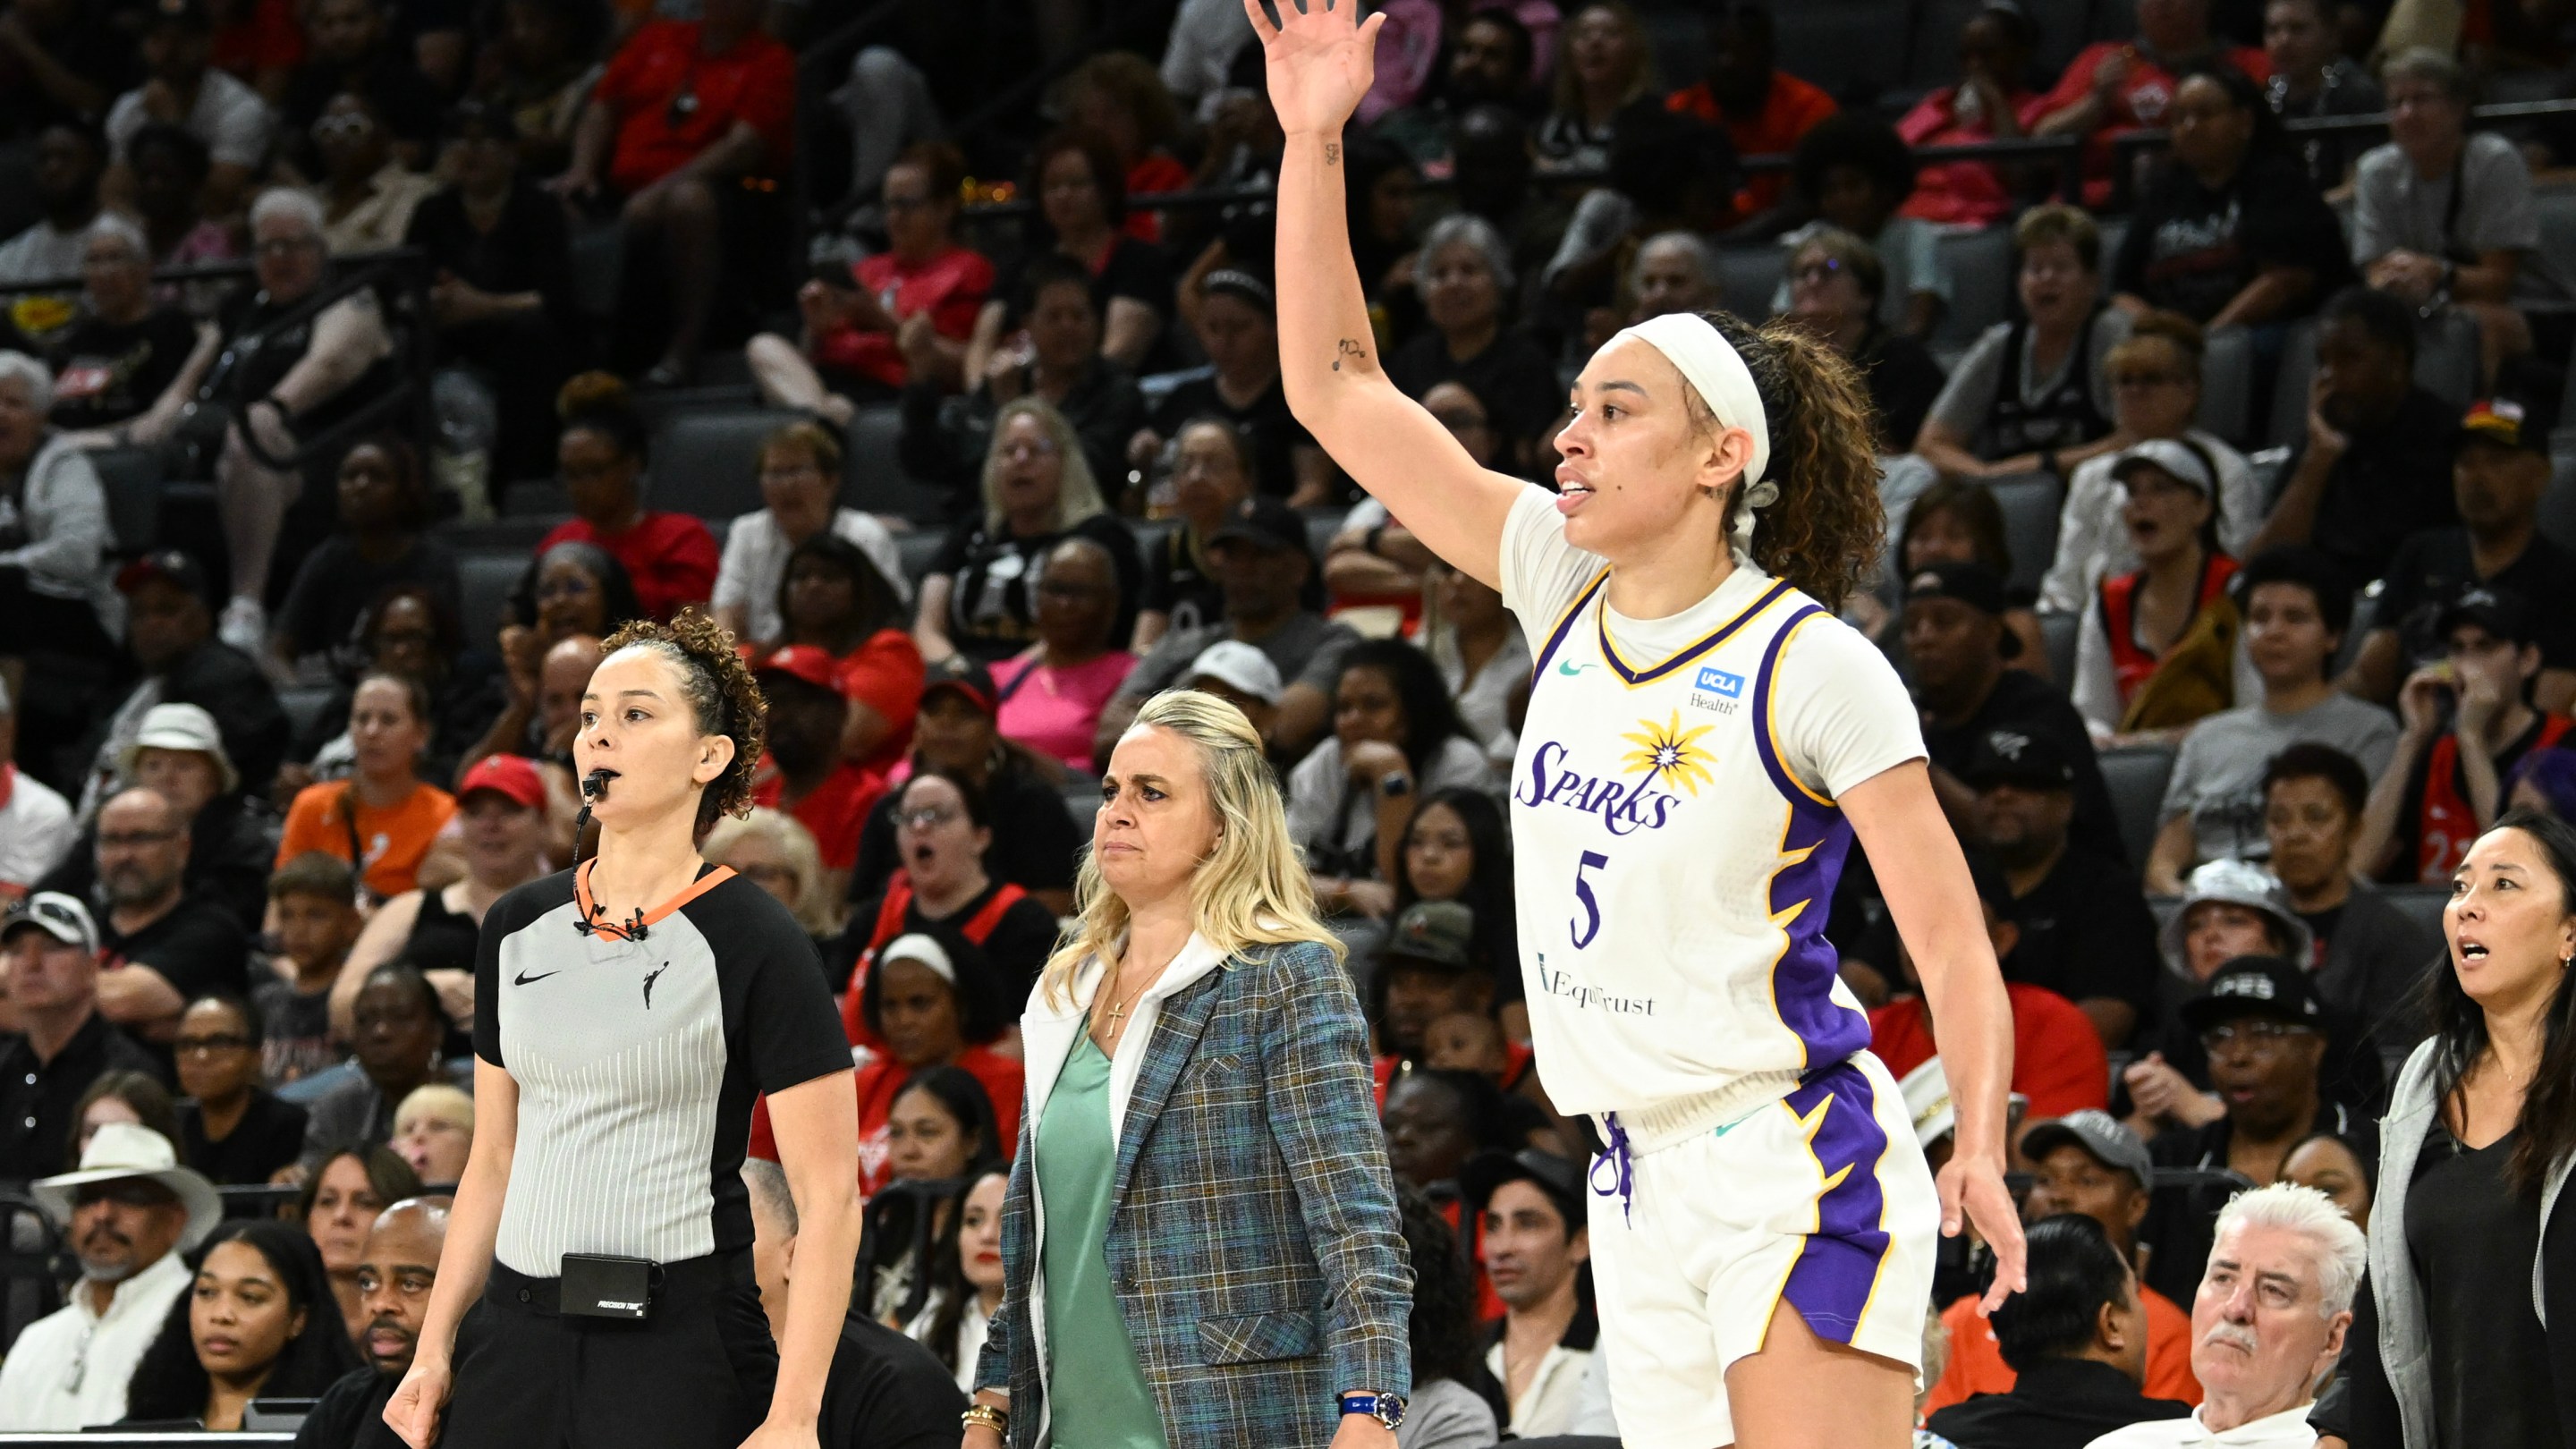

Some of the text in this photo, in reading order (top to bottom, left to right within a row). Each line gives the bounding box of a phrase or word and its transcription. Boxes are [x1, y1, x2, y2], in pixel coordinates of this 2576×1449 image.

[1700, 672, 1736, 693] UCLA
[1570, 849, 1609, 950] 5
[597, 1301, 626, 1309] PRECISION
